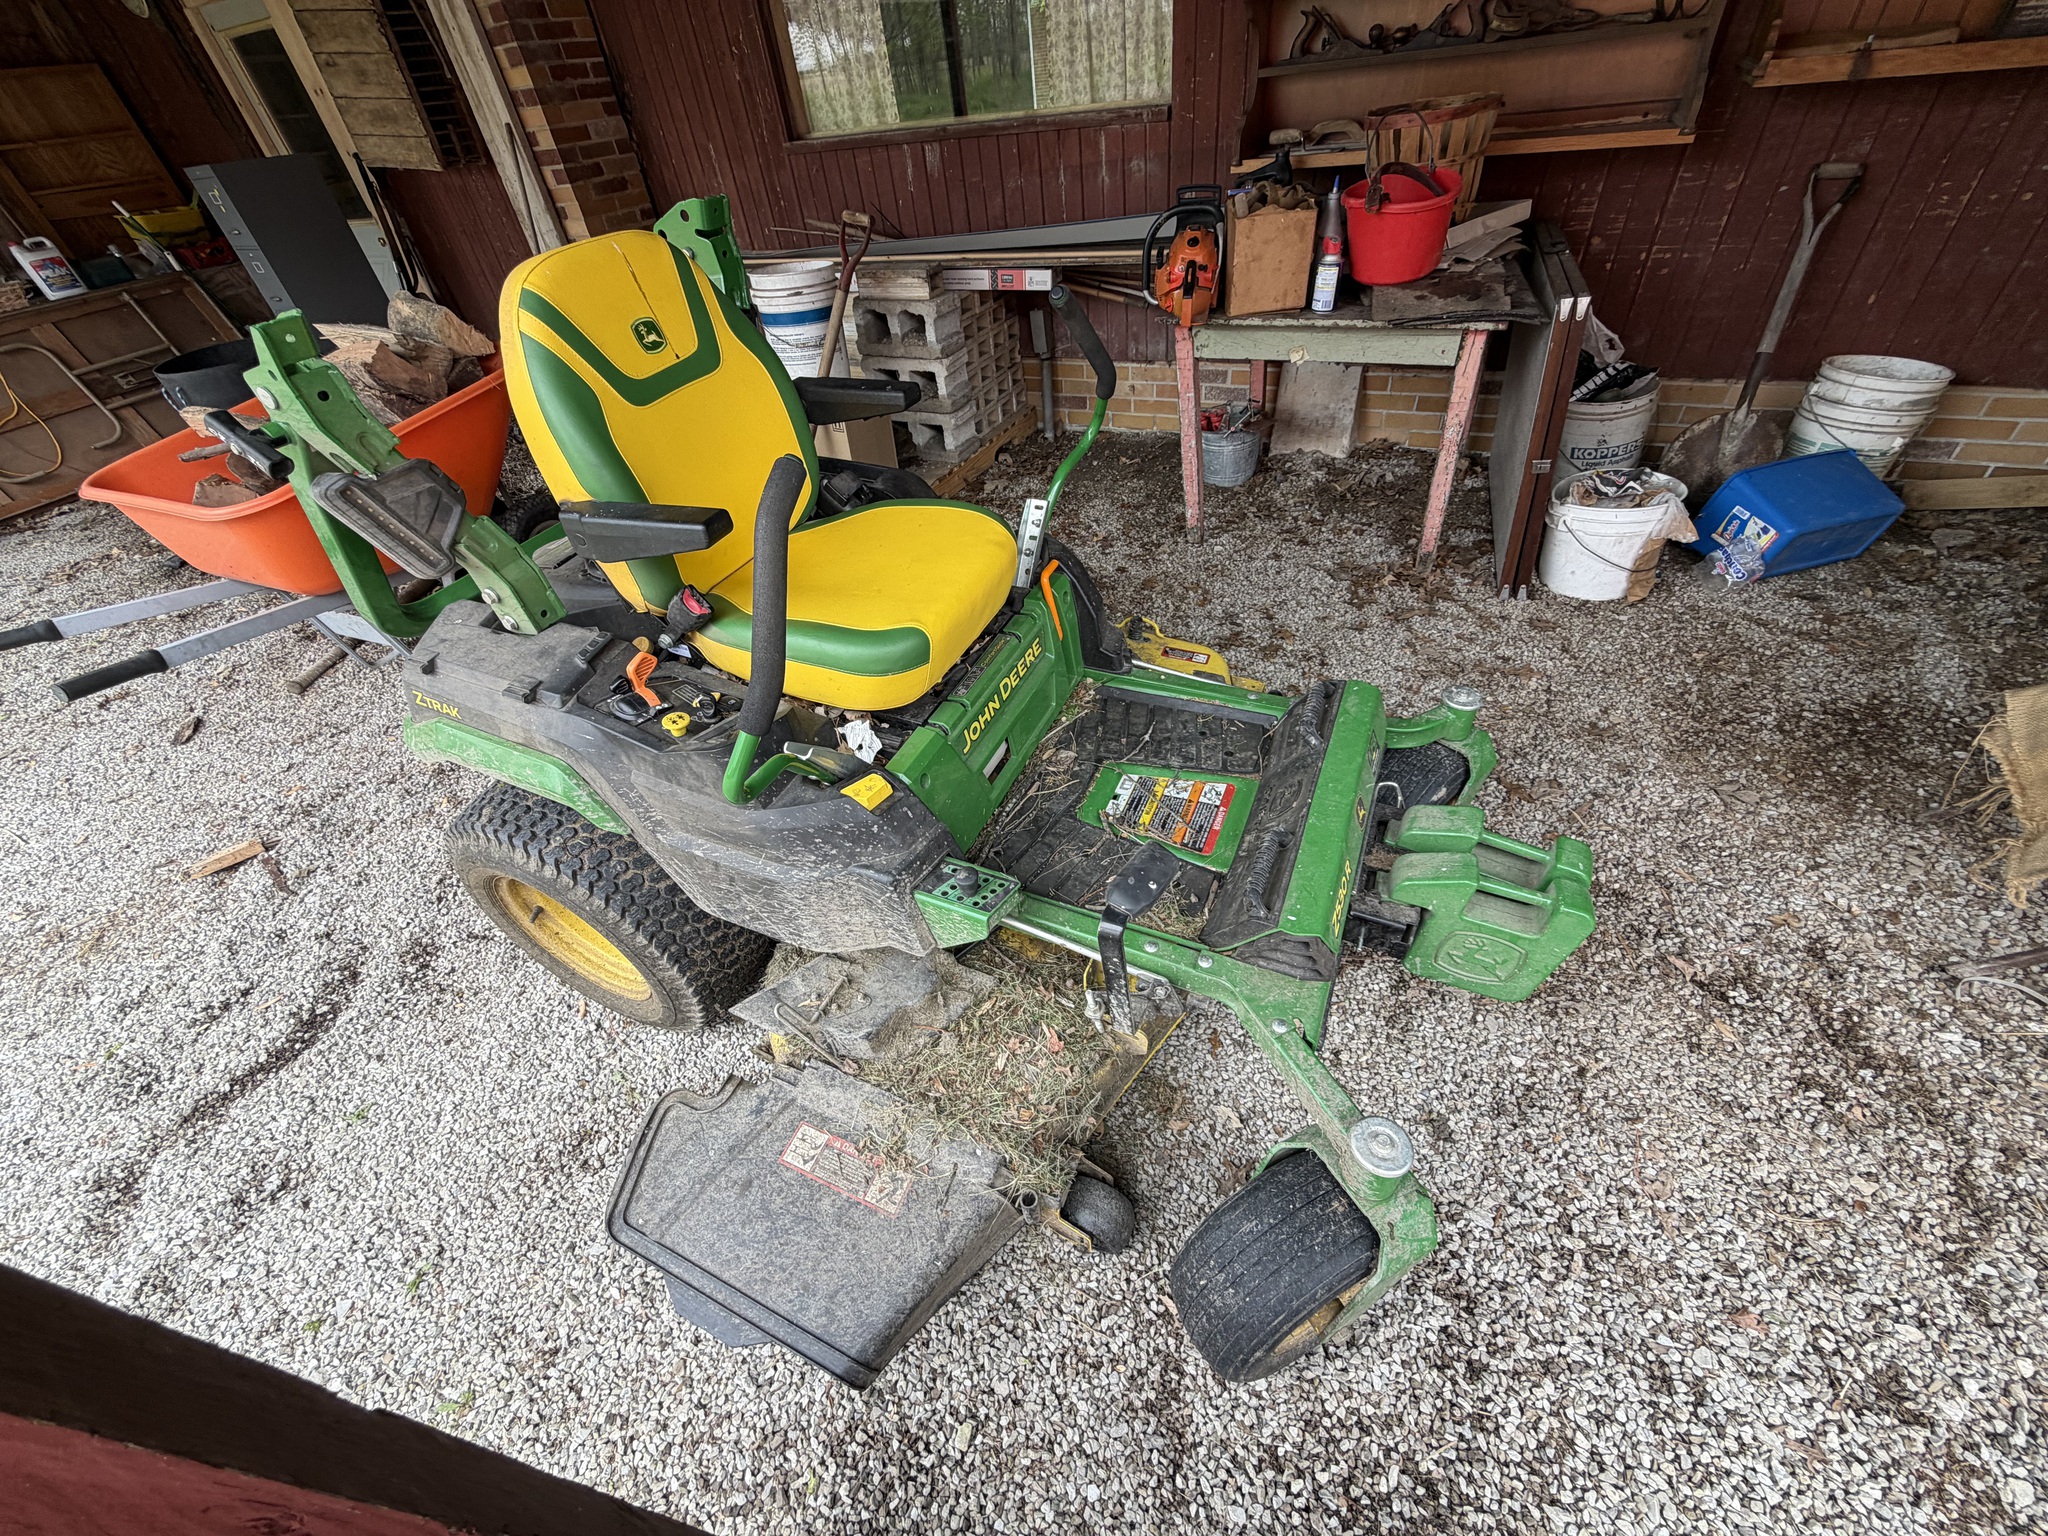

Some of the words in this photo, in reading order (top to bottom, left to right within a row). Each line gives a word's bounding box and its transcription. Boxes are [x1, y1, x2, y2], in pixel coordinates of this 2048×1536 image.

[1573, 440, 1643, 459] KOPPERS
[411, 690, 463, 720] ZTRAK
[962, 694, 1001, 754] JOHN
[999, 637, 1042, 701] DEERE
[1213, 811, 1225, 830] DANGER
